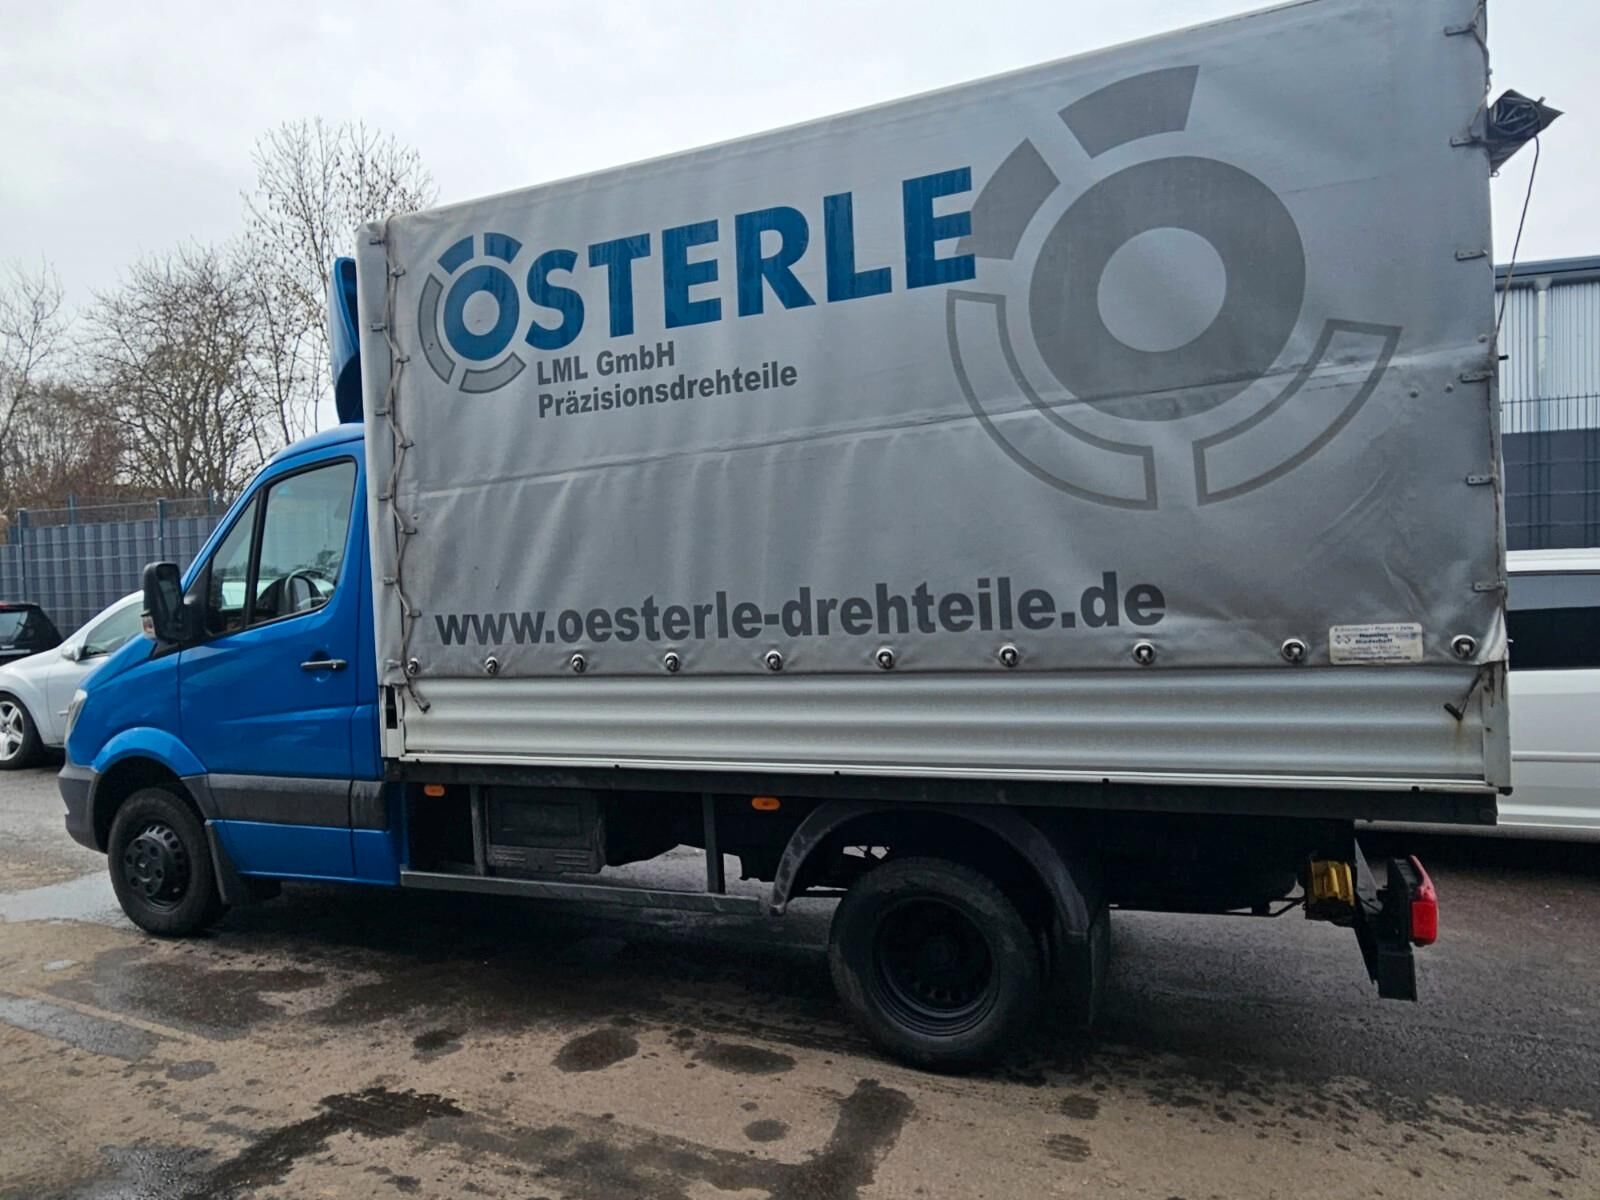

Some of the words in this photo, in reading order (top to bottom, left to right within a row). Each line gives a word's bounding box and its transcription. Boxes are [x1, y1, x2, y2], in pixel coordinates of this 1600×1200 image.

[436, 165, 977, 362] ÖSTERLE
[537, 355, 589, 386] LML
[596, 340, 676, 377] GmbH
[538, 361, 798, 418] Präzisionsdrehteile
[435, 571, 1167, 646] www.oesterle-drehteile.de
